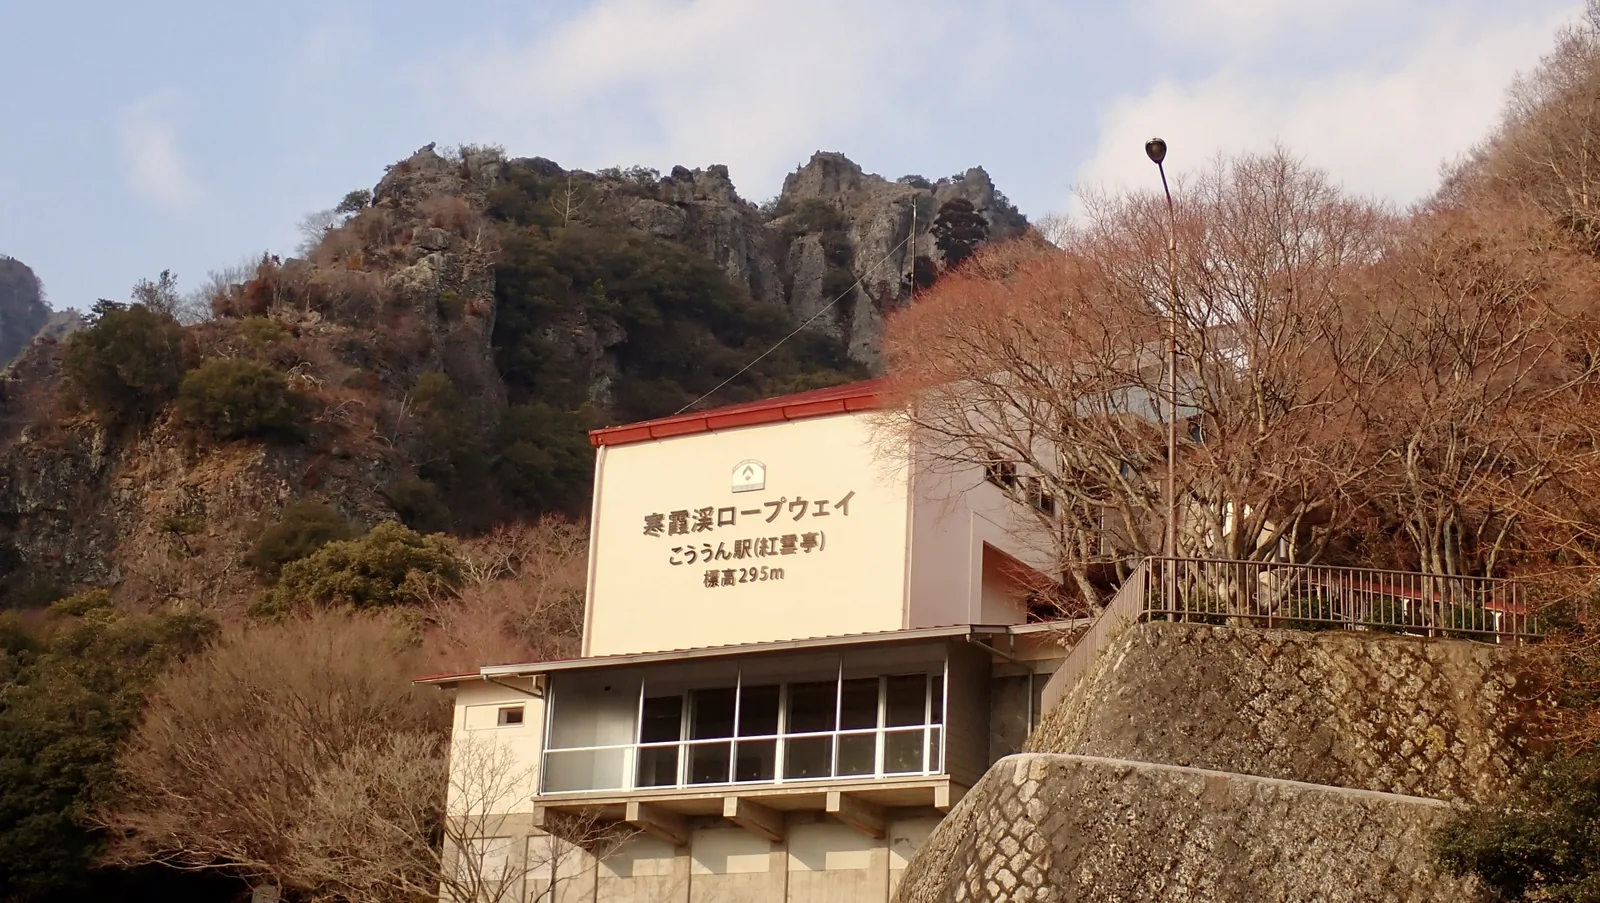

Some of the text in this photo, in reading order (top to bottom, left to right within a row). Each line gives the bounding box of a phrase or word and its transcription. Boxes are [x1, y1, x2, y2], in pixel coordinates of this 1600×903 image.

[642, 490, 856, 538] 寒霞渓ロープウェイ
[669, 530, 826, 566] こううん駅(紅雲亭)
[702, 565, 785, 589] 標高295m
